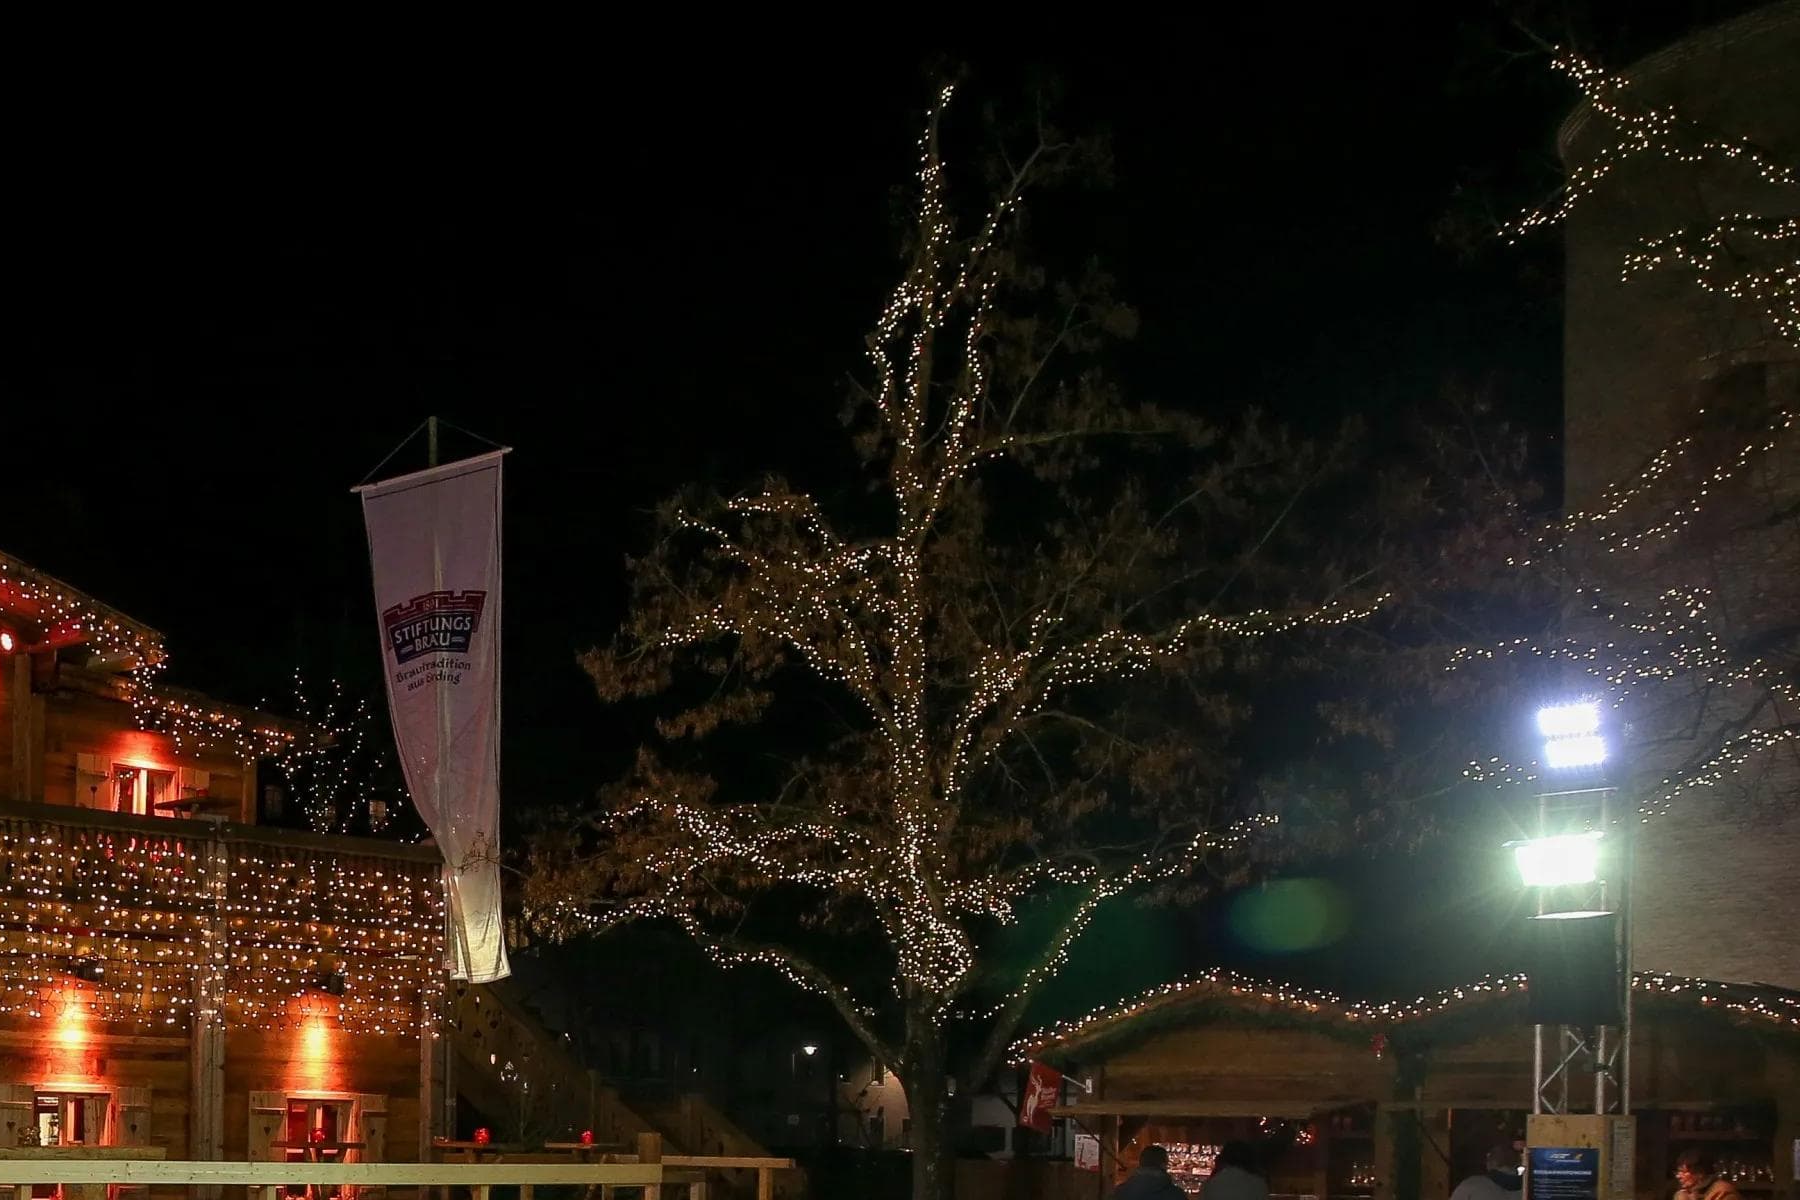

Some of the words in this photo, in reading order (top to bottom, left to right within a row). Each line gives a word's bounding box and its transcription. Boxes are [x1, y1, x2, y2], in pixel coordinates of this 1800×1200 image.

[395, 617, 471, 644] STIFTUNGS
[415, 632, 450, 651] BRÄU
[396, 658, 471, 682] Brautradition
[407, 680, 425, 691] aus
